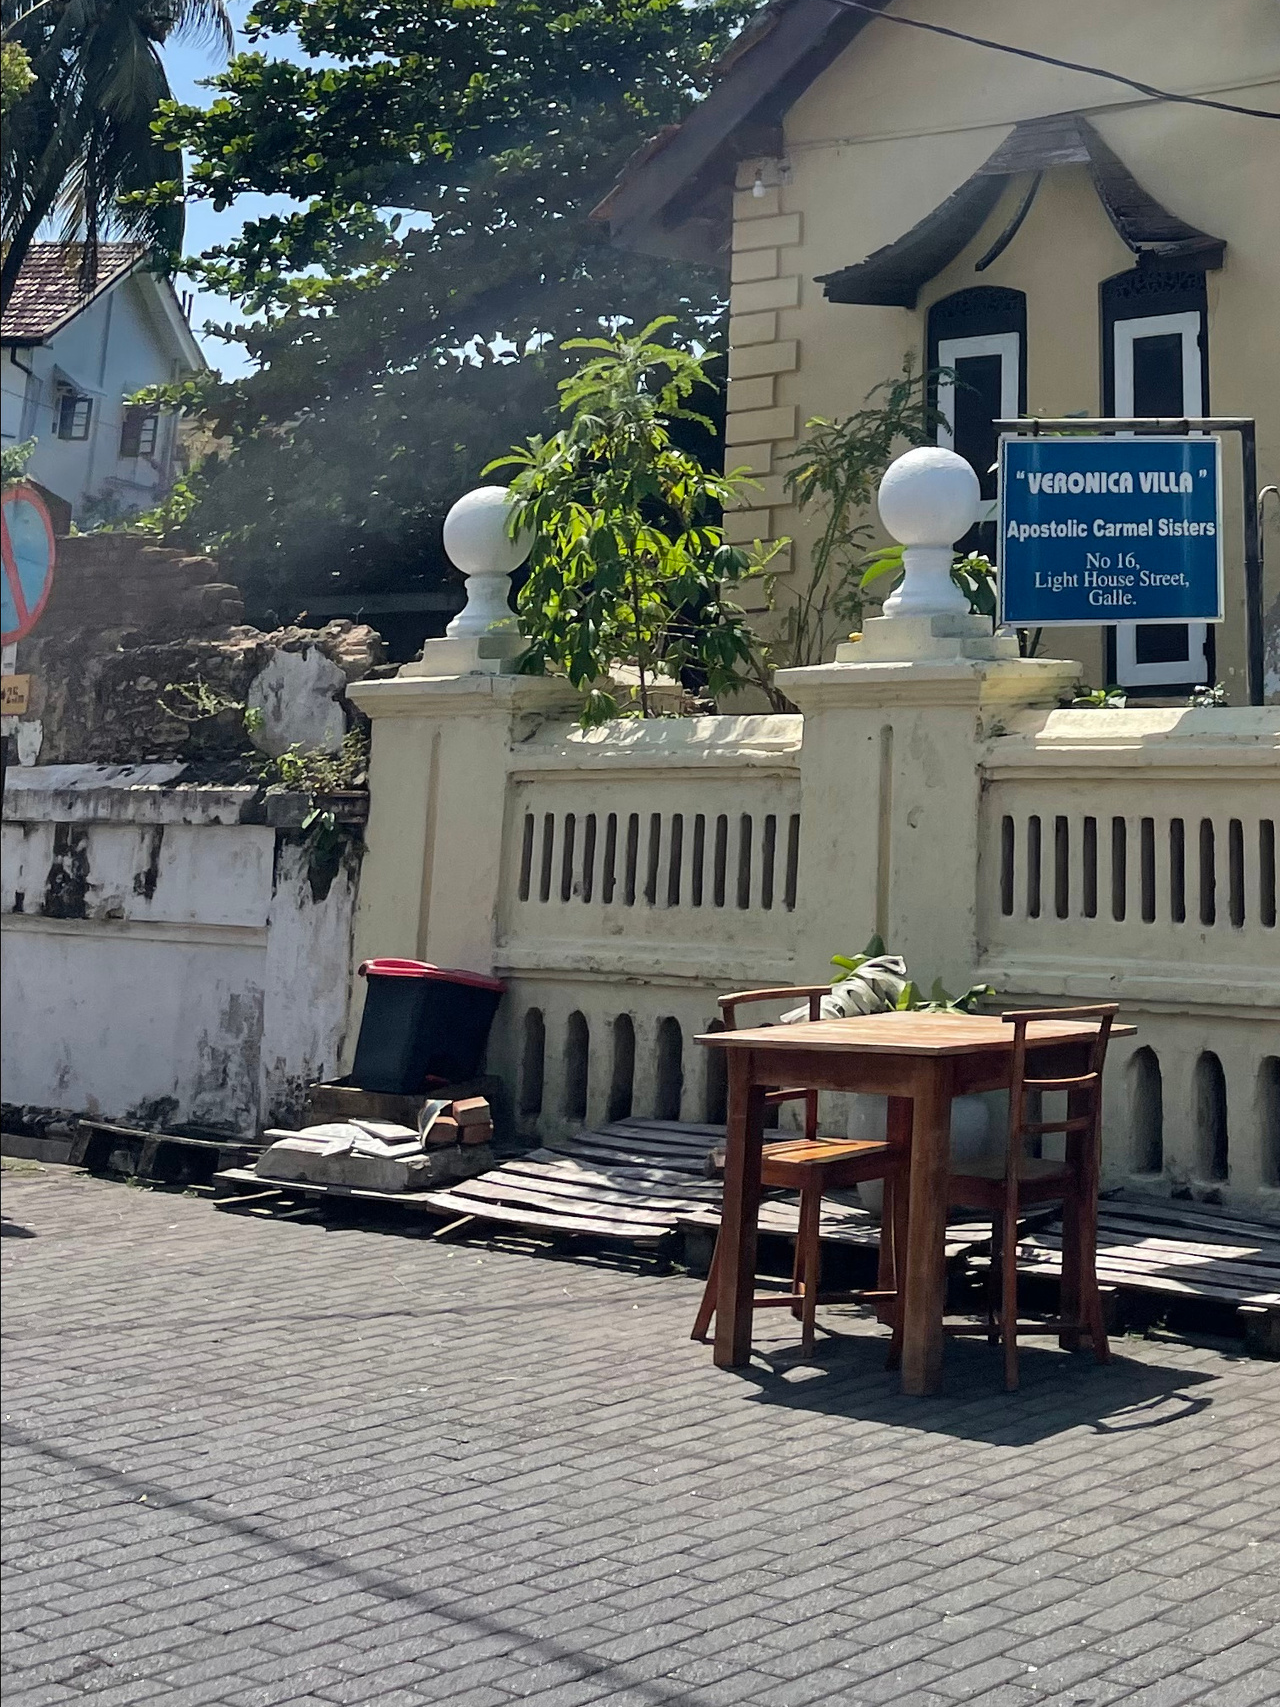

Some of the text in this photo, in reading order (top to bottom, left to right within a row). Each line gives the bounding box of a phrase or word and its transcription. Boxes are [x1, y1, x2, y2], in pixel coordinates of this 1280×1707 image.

[1007, 518, 1216, 543] Apostolic Carmel Sisters
[1086, 551, 1140, 570] No 16,
[1034, 569, 1190, 592] Light House Street,
[1088, 589, 1137, 606] Galle.
